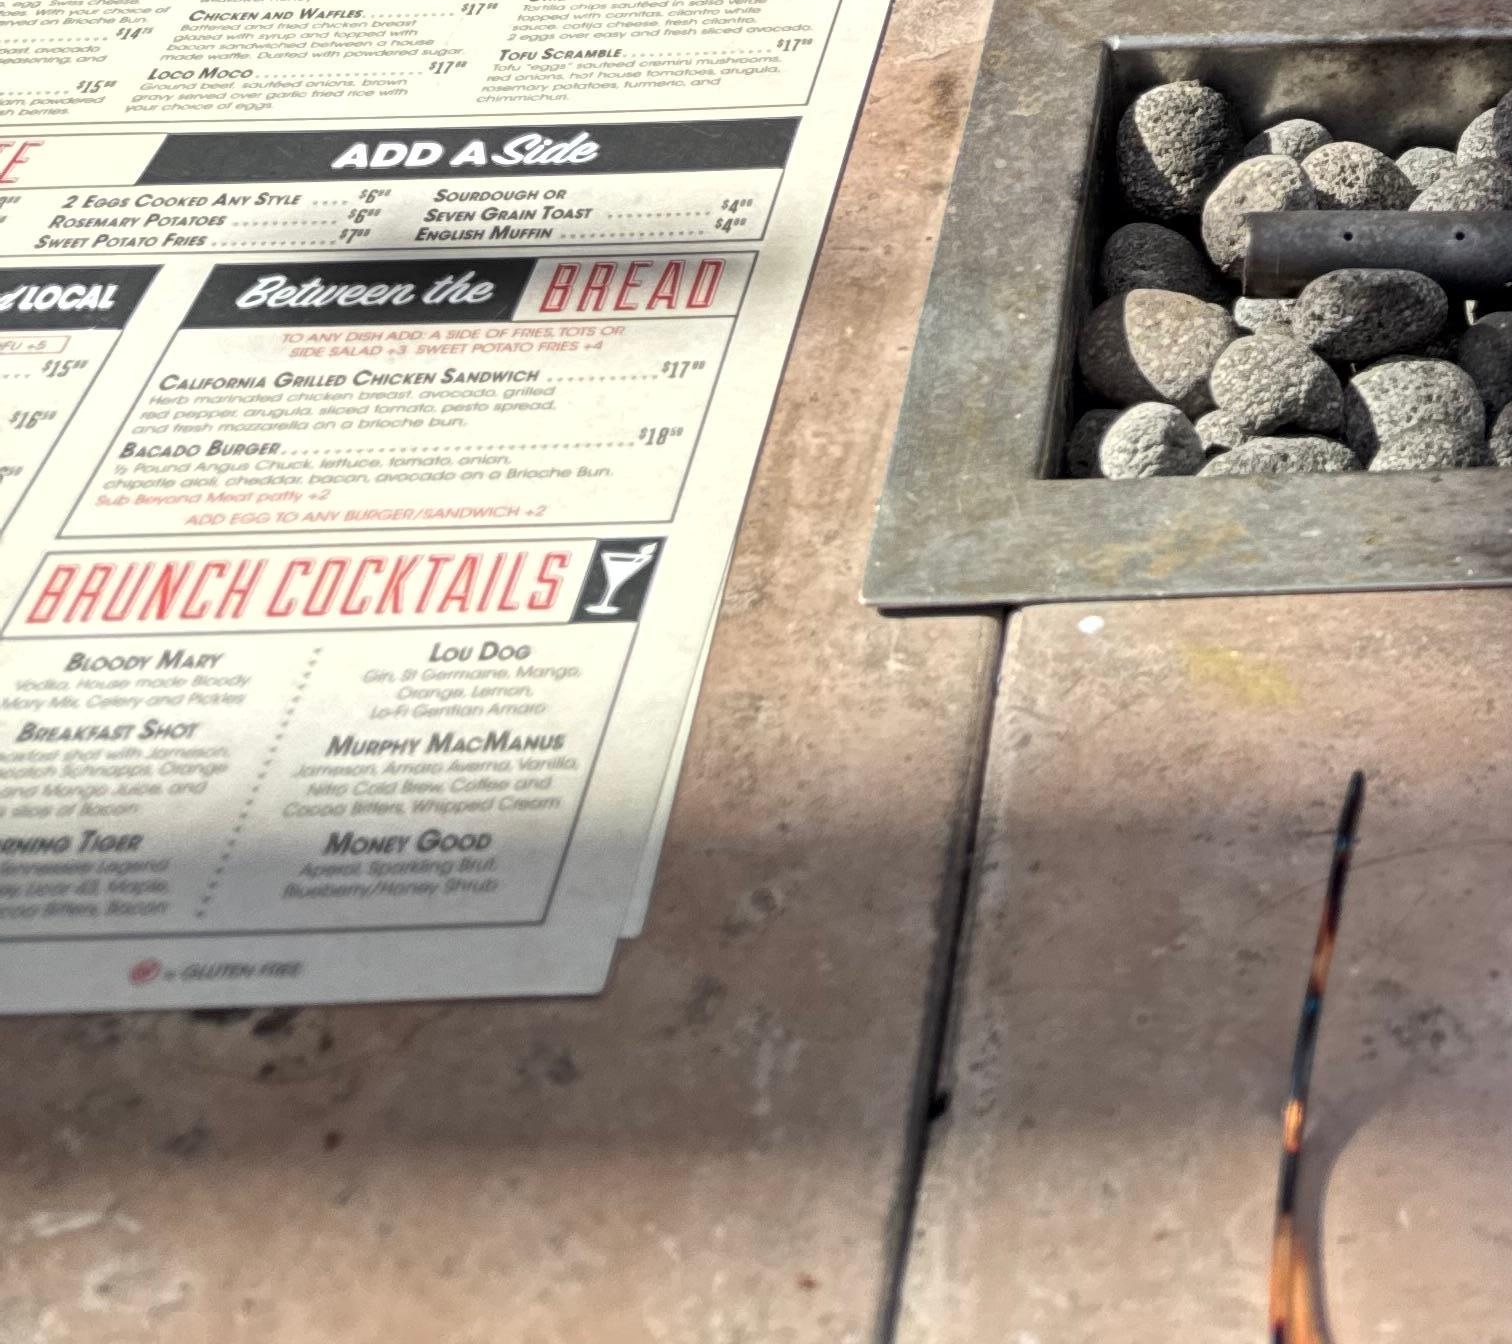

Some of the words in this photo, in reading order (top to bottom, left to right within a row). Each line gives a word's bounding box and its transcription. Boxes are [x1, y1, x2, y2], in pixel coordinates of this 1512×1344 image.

[330, 141, 444, 169] ADD
[449, 139, 488, 168] A
[490, 130, 601, 167] Side
[61, 194, 79, 208] 2
[235, 274, 417, 311] Between
[422, 269, 495, 306] the
[539, 257, 726, 314] BREAD
[18, 283, 119, 311] LOCAL
[282, 332, 304, 344] TO
[307, 332, 343, 344] ANY
[345, 331, 384, 343] DISH
[428, 330, 442, 341] A
[445, 328, 480, 340] SIDE
[485, 327, 510, 339] OF
[558, 325, 597, 337] TOTS
[600, 325, 626, 337] OR
[288, 346, 323, 358] SIDE
[328, 345, 384, 357] SALAD
[387, 345, 408, 356] +3
[415, 343, 468, 355] SWEET
[471, 342, 534, 354] POTATO
[538, 341, 580, 353] FRIES
[583, 340, 604, 352] +4
[149, 395, 190, 406] Herb
[193, 392, 284, 404] marinated
[287, 390, 354, 403] chicken
[502, 386, 557, 400] grilled
[184, 513, 227, 526] ADD
[229, 512, 271, 525] EGG
[275, 511, 300, 523] TO
[301, 510, 340, 523] ANY
[25, 556, 270, 624] BRUNCH
[265, 551, 573, 618] COCKTAILS
